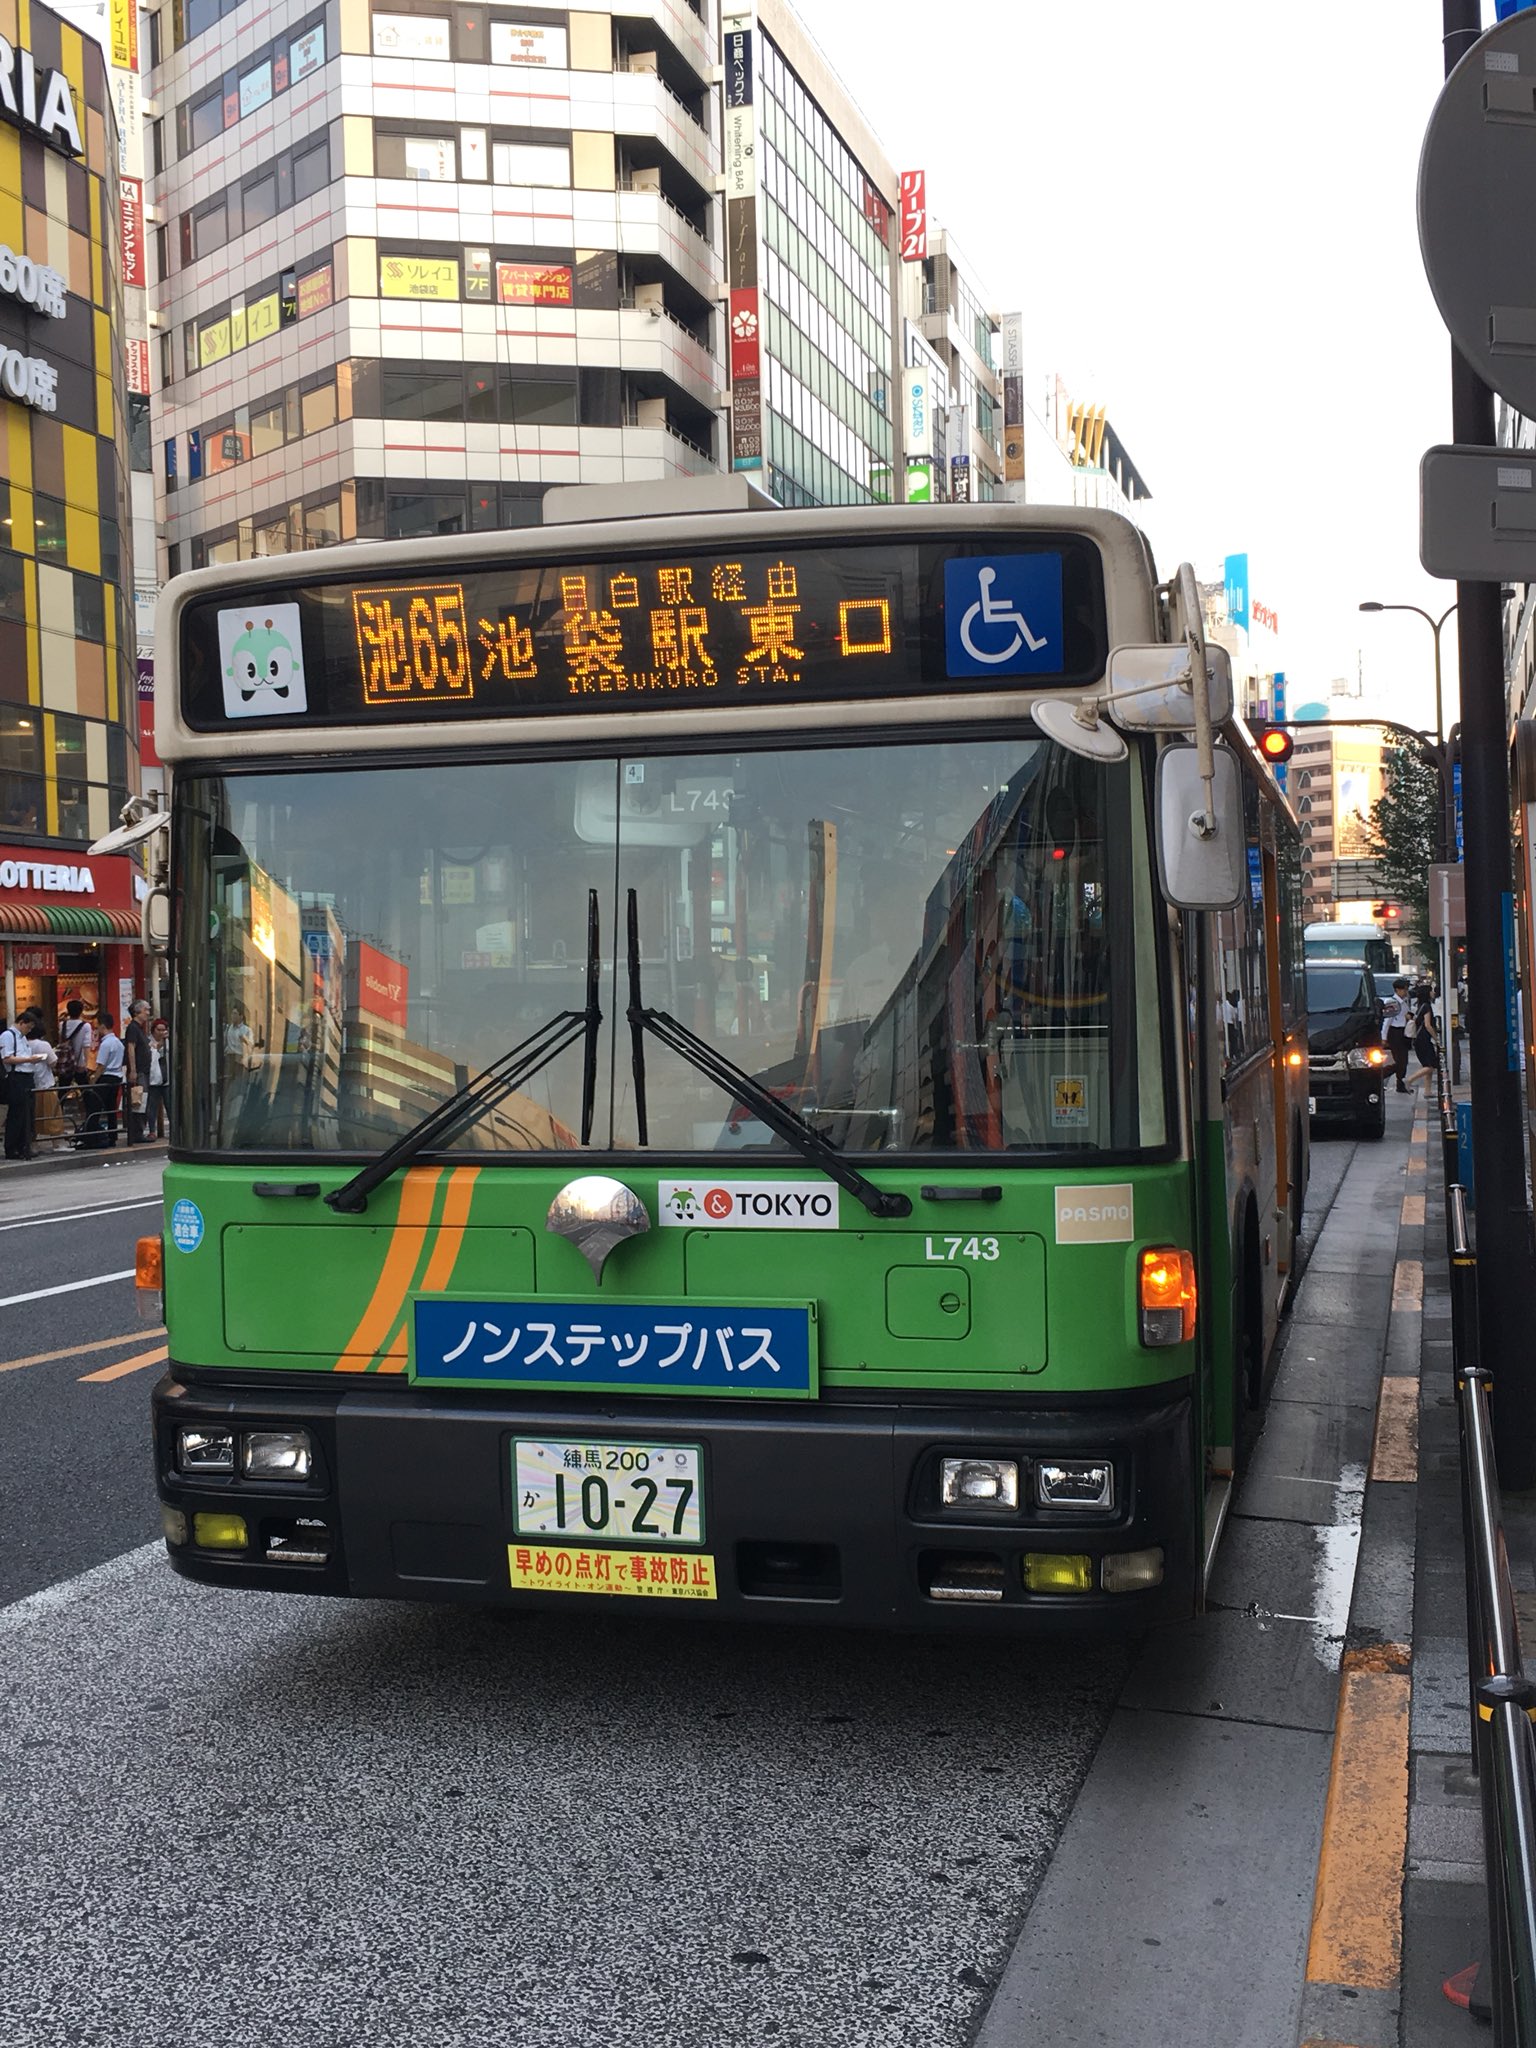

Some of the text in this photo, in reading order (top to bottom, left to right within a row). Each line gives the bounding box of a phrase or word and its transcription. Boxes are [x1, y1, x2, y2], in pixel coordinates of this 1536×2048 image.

[733, 115, 745, 190] Whitening BAR
[903, 173, 926, 257] リーブ21
[123, 202, 136, 281] ユニオンアセット
[407, 264, 454, 281] ソレイユ
[409, 284, 438, 295] 池袋店
[467, 277, 489, 290] 7F
[0, 344, 58, 411] 0席
[561, 561, 798, 612] 目白駅経由
[361, 595, 465, 692] 池65
[478, 599, 892, 681] 池袋駅東口
[568, 666, 801, 695] IKEBUKURO STA.
[0, 860, 95, 893] OTTERIA
[711, 1193, 832, 1216] & TOKYO
[1060, 1205, 1130, 1222] PASMO
[925, 1237, 1000, 1261] L743
[442, 1321, 781, 1373] ノンステップバス
[563, 1449, 650, 1471] 練馬 200
[523, 1490, 541, 1508] か
[555, 1473, 694, 1535] 10-27
[516, 1549, 710, 1586] 早めの点灯で事故防止
